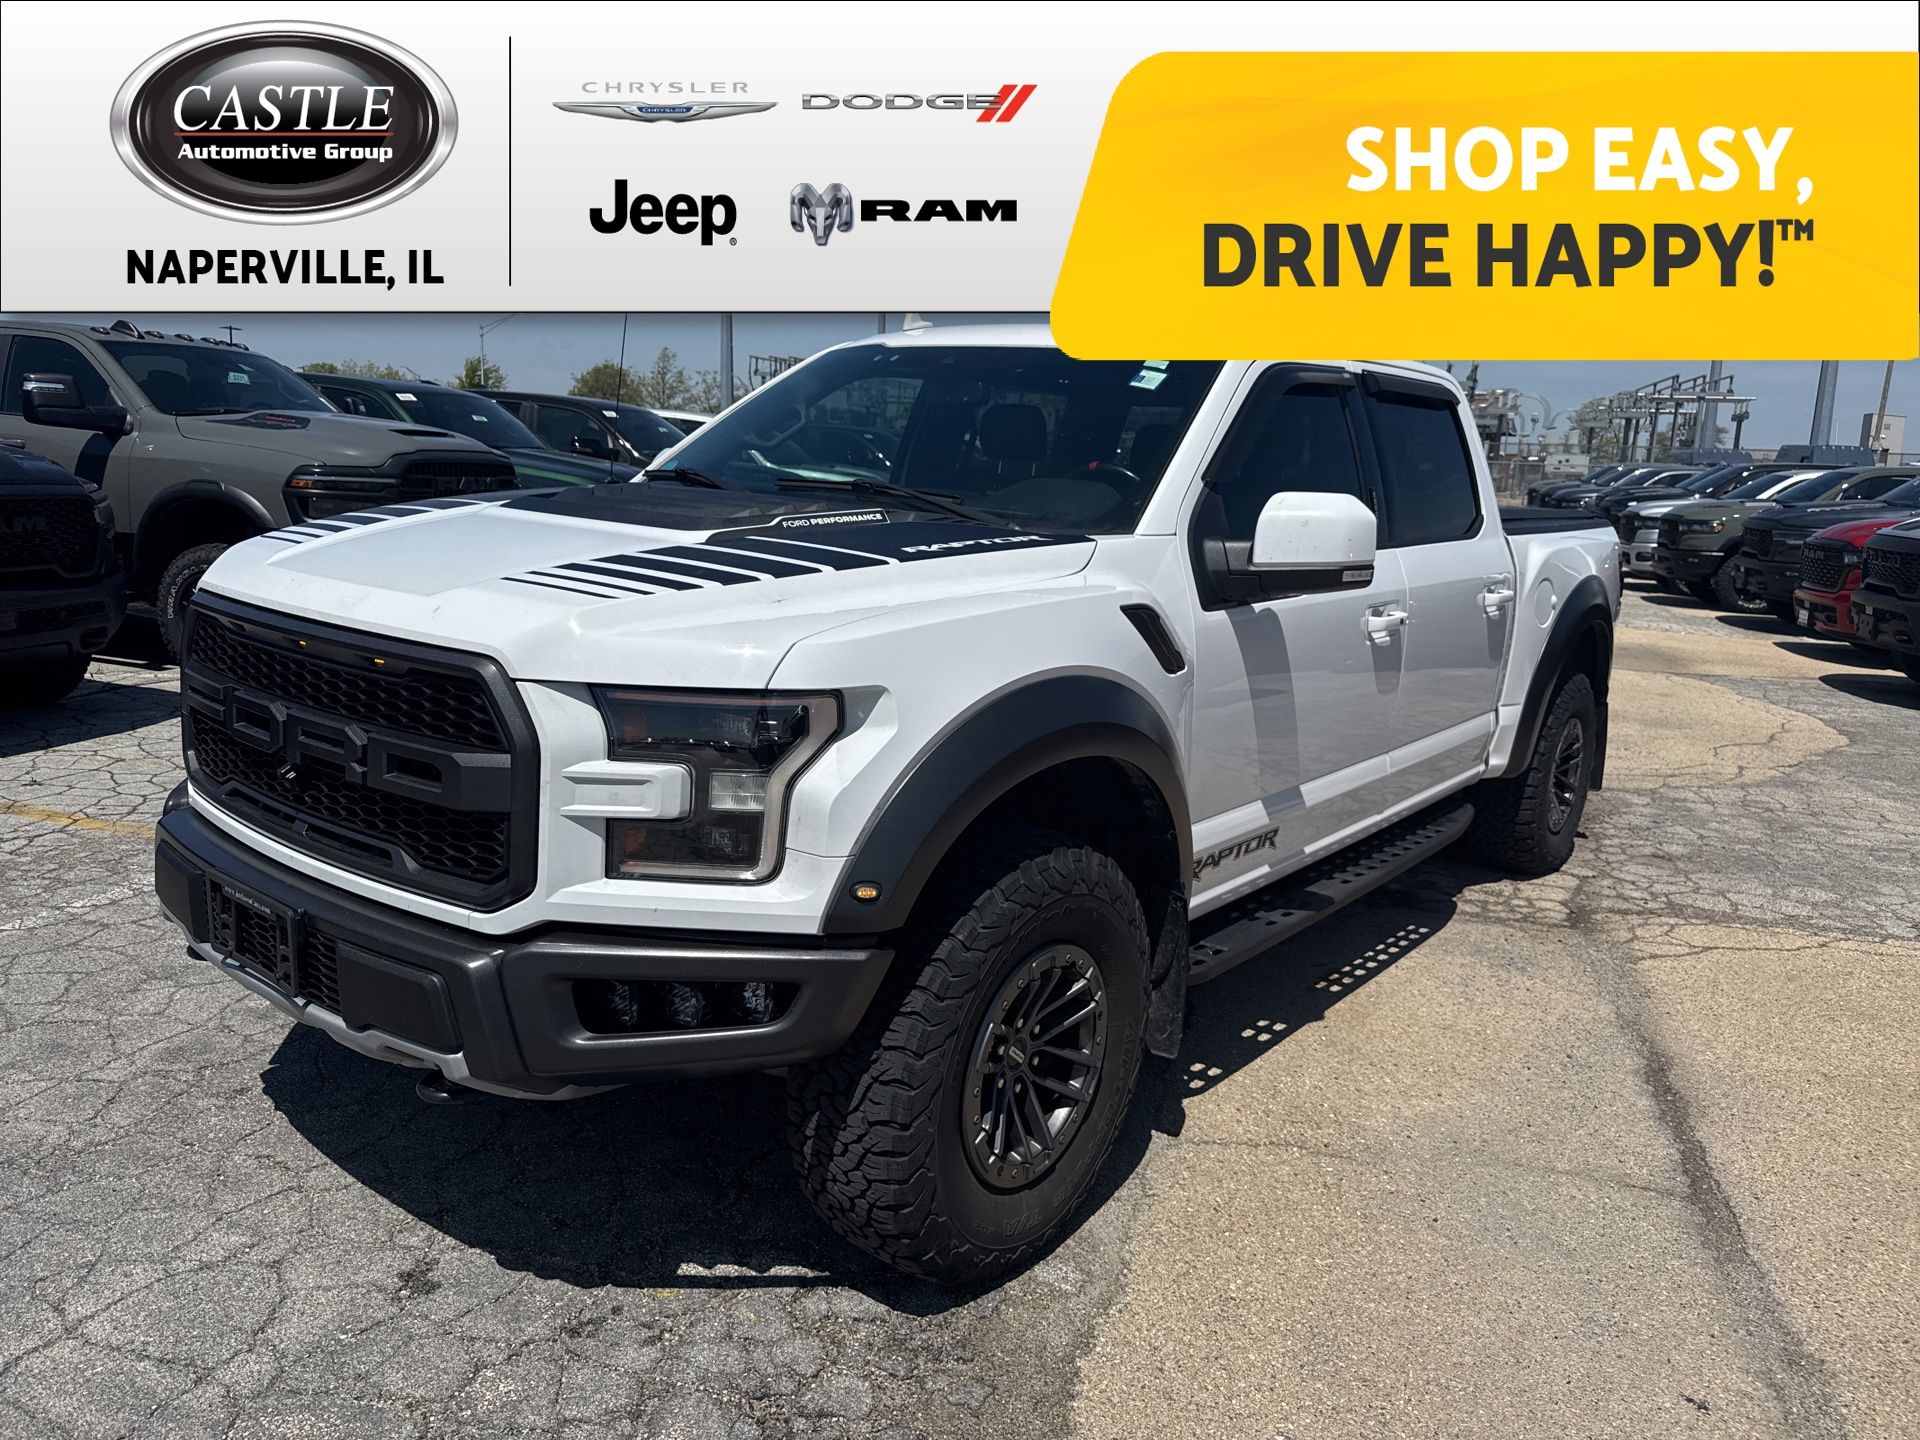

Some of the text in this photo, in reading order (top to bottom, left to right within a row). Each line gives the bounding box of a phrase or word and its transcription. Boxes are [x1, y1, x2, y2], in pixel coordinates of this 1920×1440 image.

[782, 513, 883, 528] FORD PERFORMANCE
[900, 535, 1054, 553] RAPTOR
[167, 564, 209, 619] WRANGLE
[183, 679, 462, 804] FORD
[1192, 826, 1280, 883] RAPTOR
